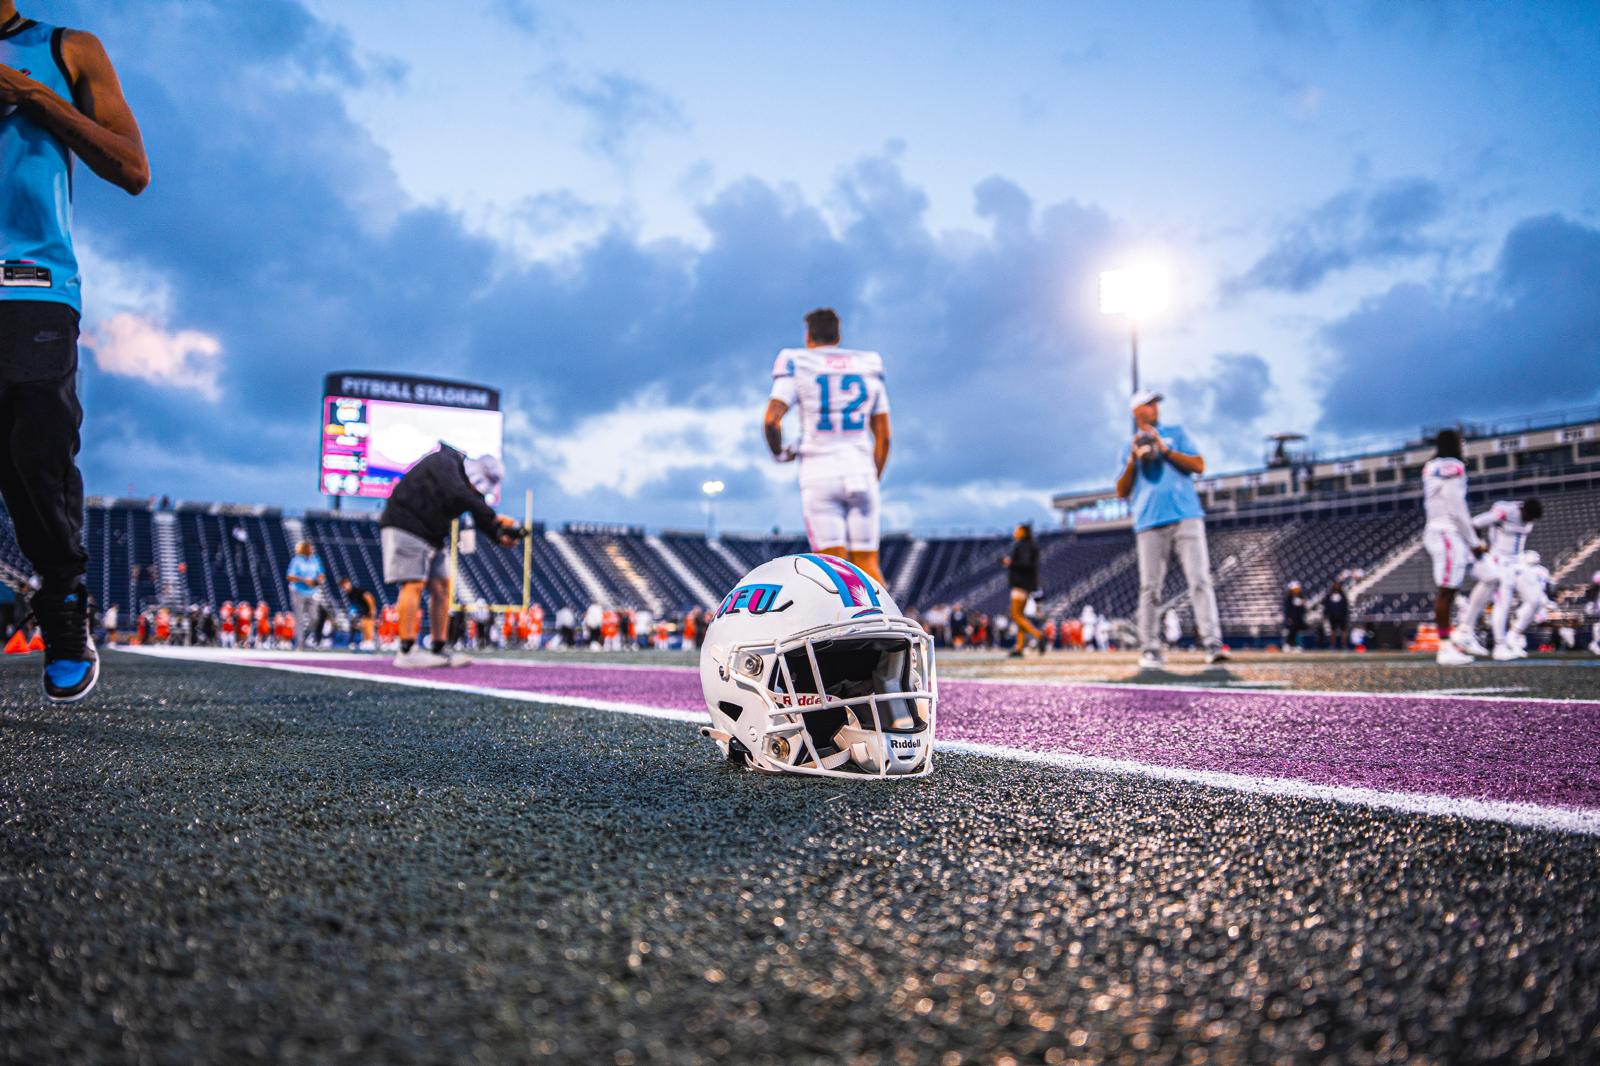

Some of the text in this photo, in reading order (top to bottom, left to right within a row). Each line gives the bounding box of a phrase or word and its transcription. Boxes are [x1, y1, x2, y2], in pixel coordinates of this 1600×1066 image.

[341, 376, 489, 407] PITBULL STADIUM
[815, 374, 867, 432] 12
[890, 739, 921, 749] Riddell
